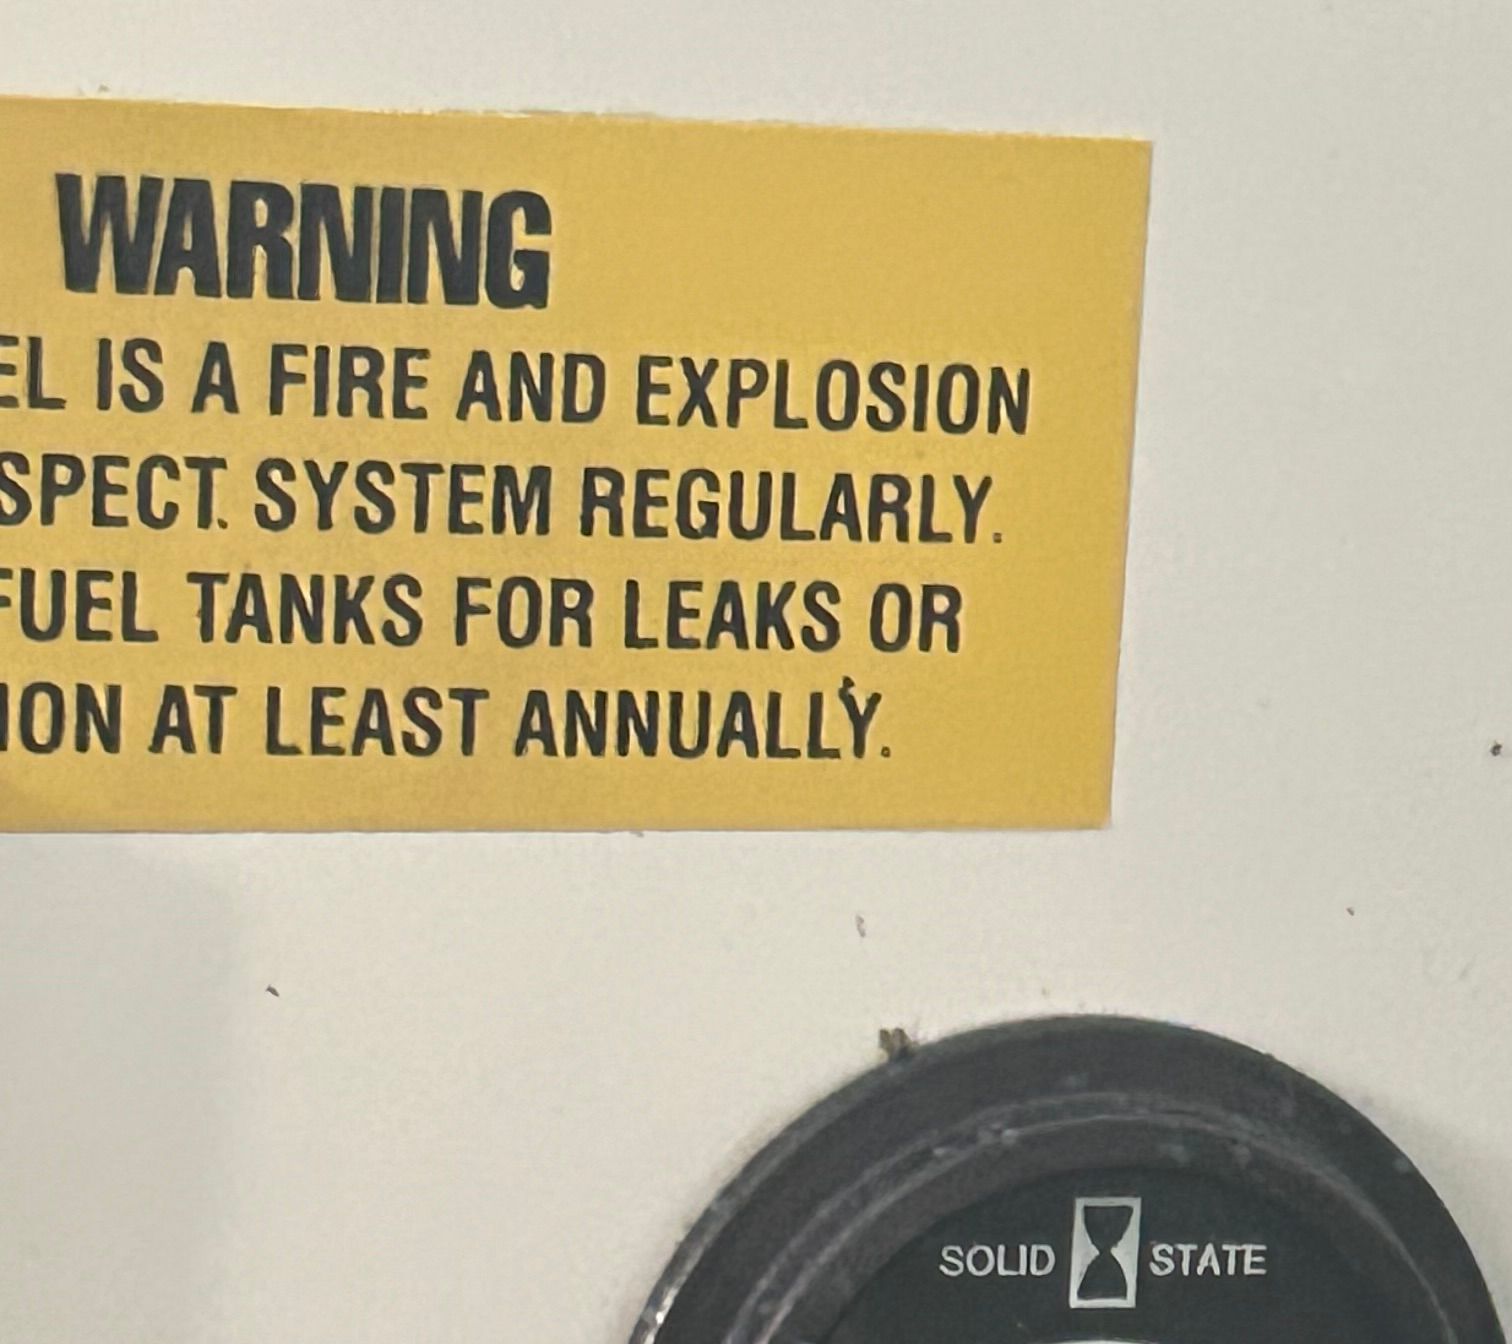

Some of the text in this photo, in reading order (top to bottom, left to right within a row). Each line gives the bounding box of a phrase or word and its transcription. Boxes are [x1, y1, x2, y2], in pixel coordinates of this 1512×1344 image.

[55, 173, 552, 310] WARNING
[97, 337, 164, 413] IS
[191, 341, 239, 414] A
[269, 343, 430, 420] FIRE
[455, 350, 606, 423] AND
[636, 355, 1031, 435] EXPLOSION
[254, 457, 552, 536] SYSTEM
[580, 466, 1003, 544] REGULARLY.
[186, 571, 423, 647] TANKS
[455, 576, 594, 649] FOR
[624, 579, 841, 653] LEAKS
[869, 582, 963, 653] OR
[148, 684, 238, 755] AT
[266, 686, 490, 757] LEAST
[514, 680, 891, 759] ANNUALLY.
[938, 1242, 1268, 1277] SOLID STATE
